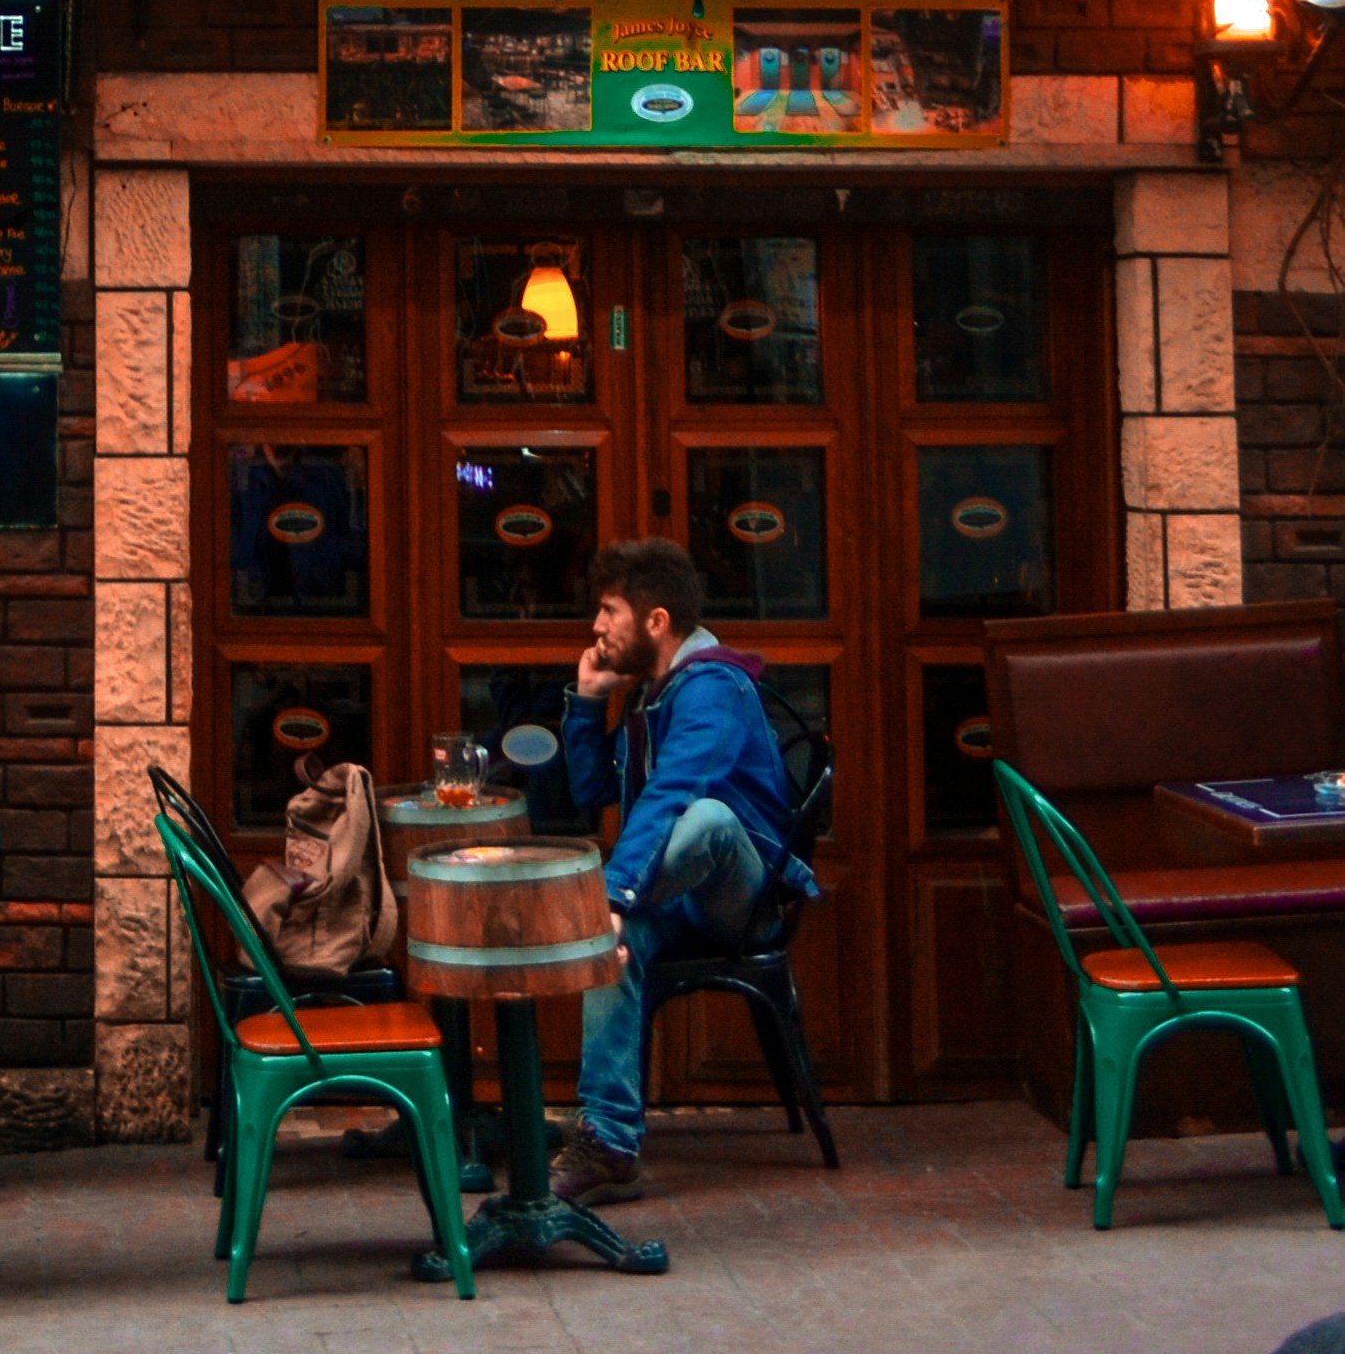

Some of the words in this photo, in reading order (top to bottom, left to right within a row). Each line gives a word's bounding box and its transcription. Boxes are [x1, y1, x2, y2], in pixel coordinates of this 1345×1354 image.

[614, 20, 665, 44] James
[667, 16, 713, 41] Joyce
[600, 49, 670, 74] ROOF
[673, 49, 728, 75] BAR
